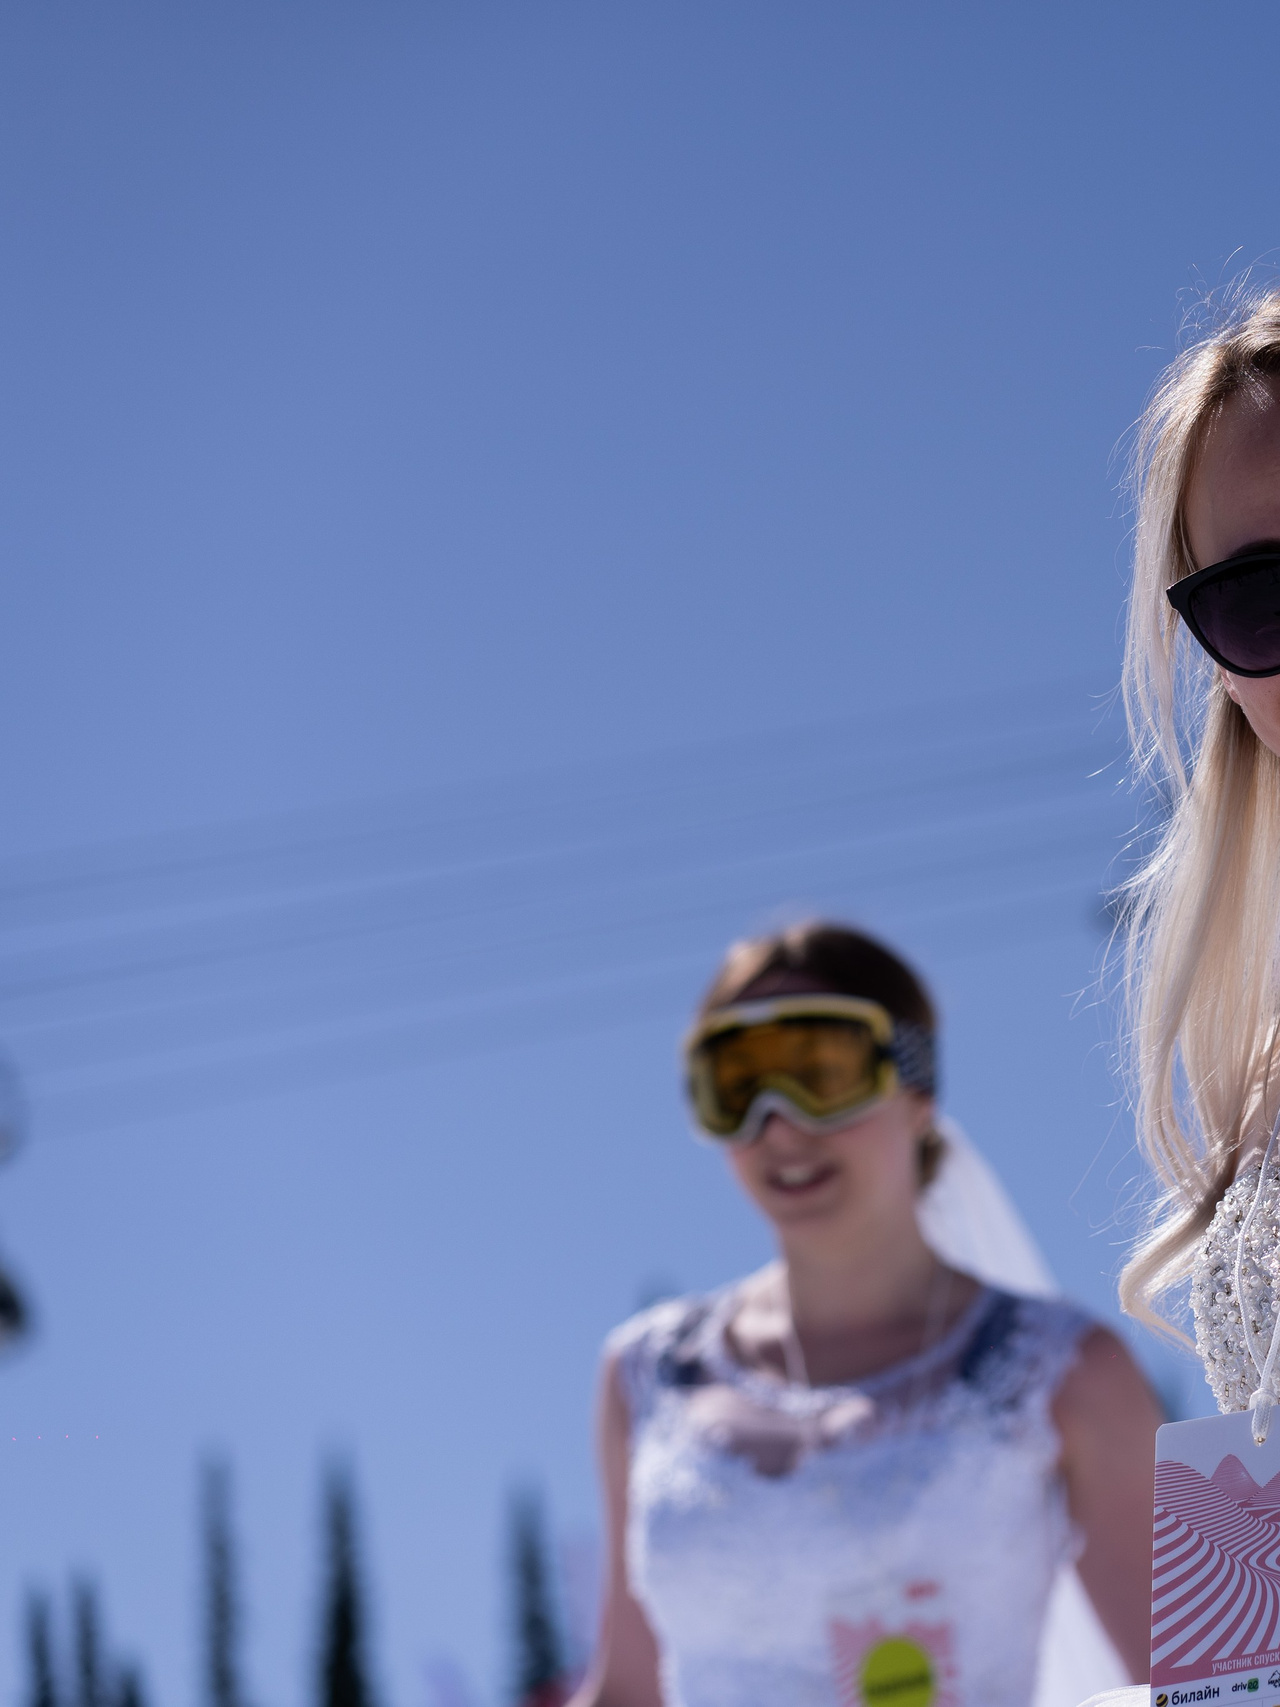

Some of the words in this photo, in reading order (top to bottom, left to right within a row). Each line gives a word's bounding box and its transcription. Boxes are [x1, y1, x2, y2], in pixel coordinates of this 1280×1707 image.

[1212, 1656, 1252, 1675] УЧАСТНИК
[1171, 1685, 1220, 1706] билайн
[1231, 1680, 1259, 1692] drivee
